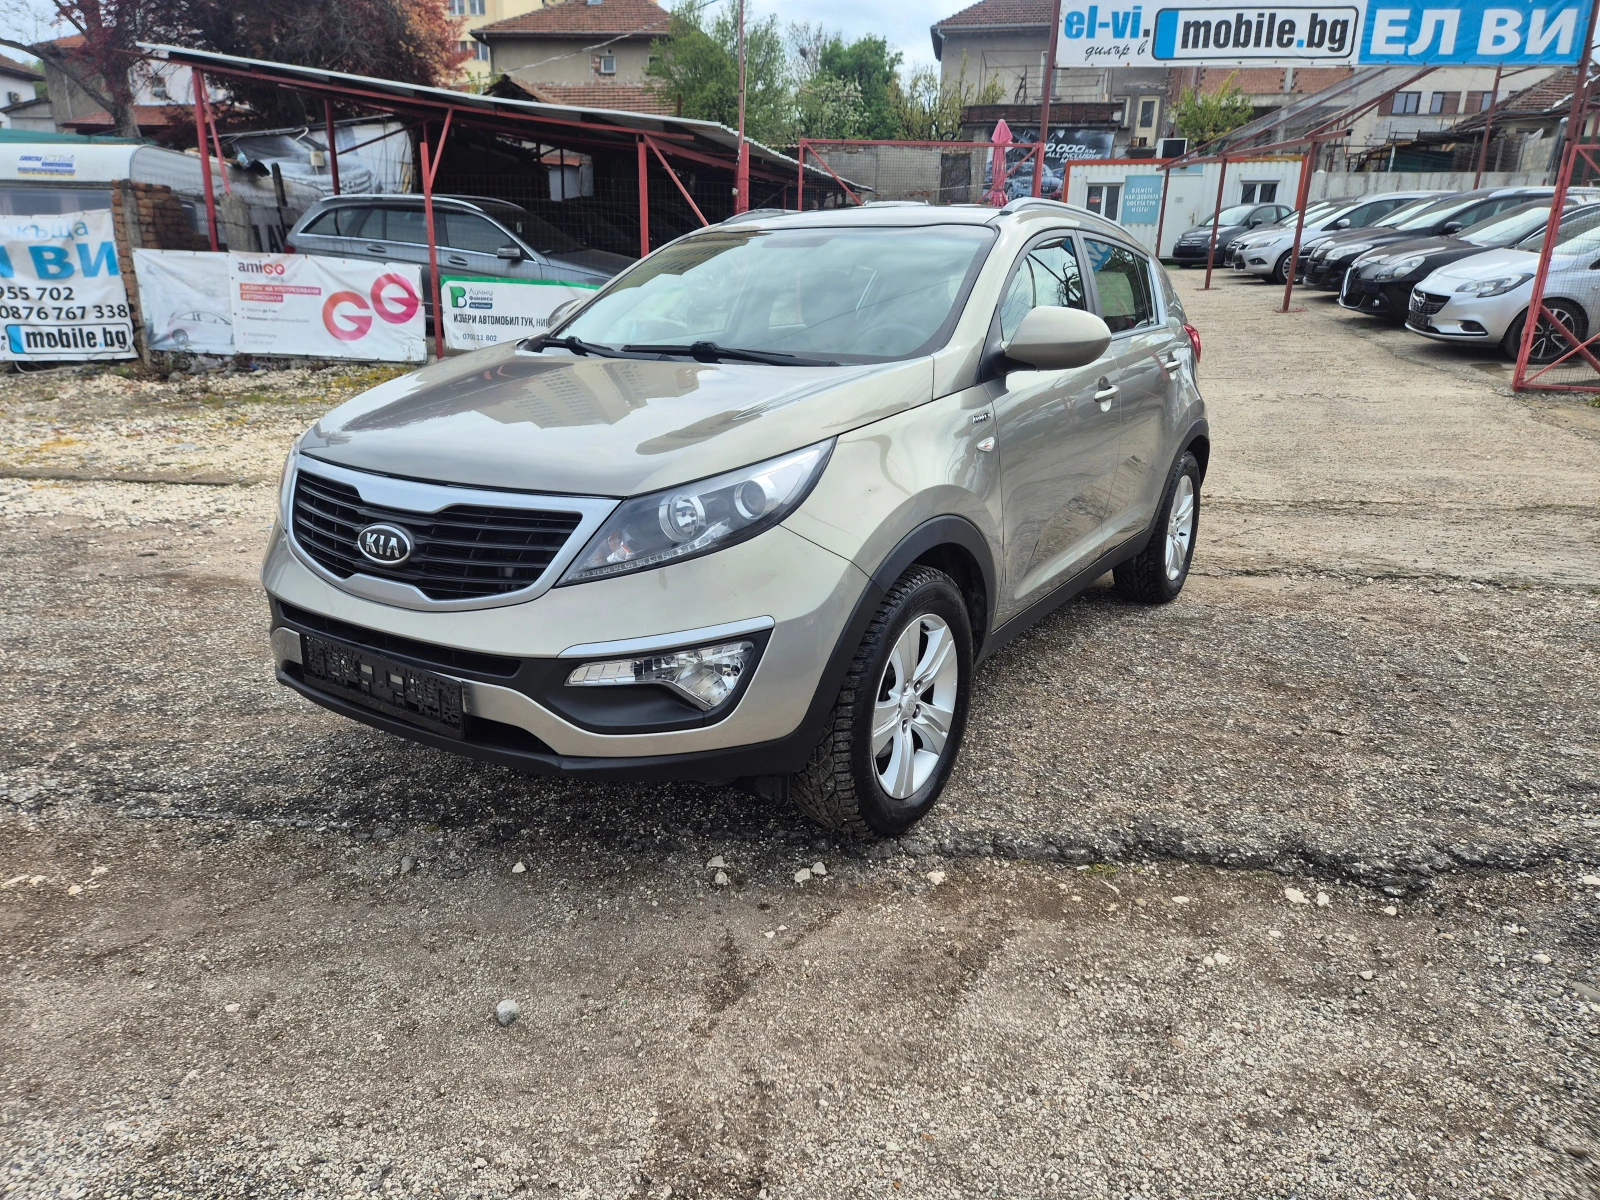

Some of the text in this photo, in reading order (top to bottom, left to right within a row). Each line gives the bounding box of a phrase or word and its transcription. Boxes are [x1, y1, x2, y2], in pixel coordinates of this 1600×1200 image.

[1181, 13, 1349, 52] mobile.bg
[1369, 9, 1579, 56] ЕЛ ВИ
[1085, 43, 1130, 60] дилър
[28, 241, 121, 280] ВИ
[36, 287, 75, 301] 702
[0, 304, 128, 320] 0876 767 338
[453, 313, 477, 324] ИЗБЕРИ
[478, 315, 519, 326] АВТОМОБИЛ
[25, 327, 127, 350] mobile.bg
[365, 532, 400, 558] KIA
